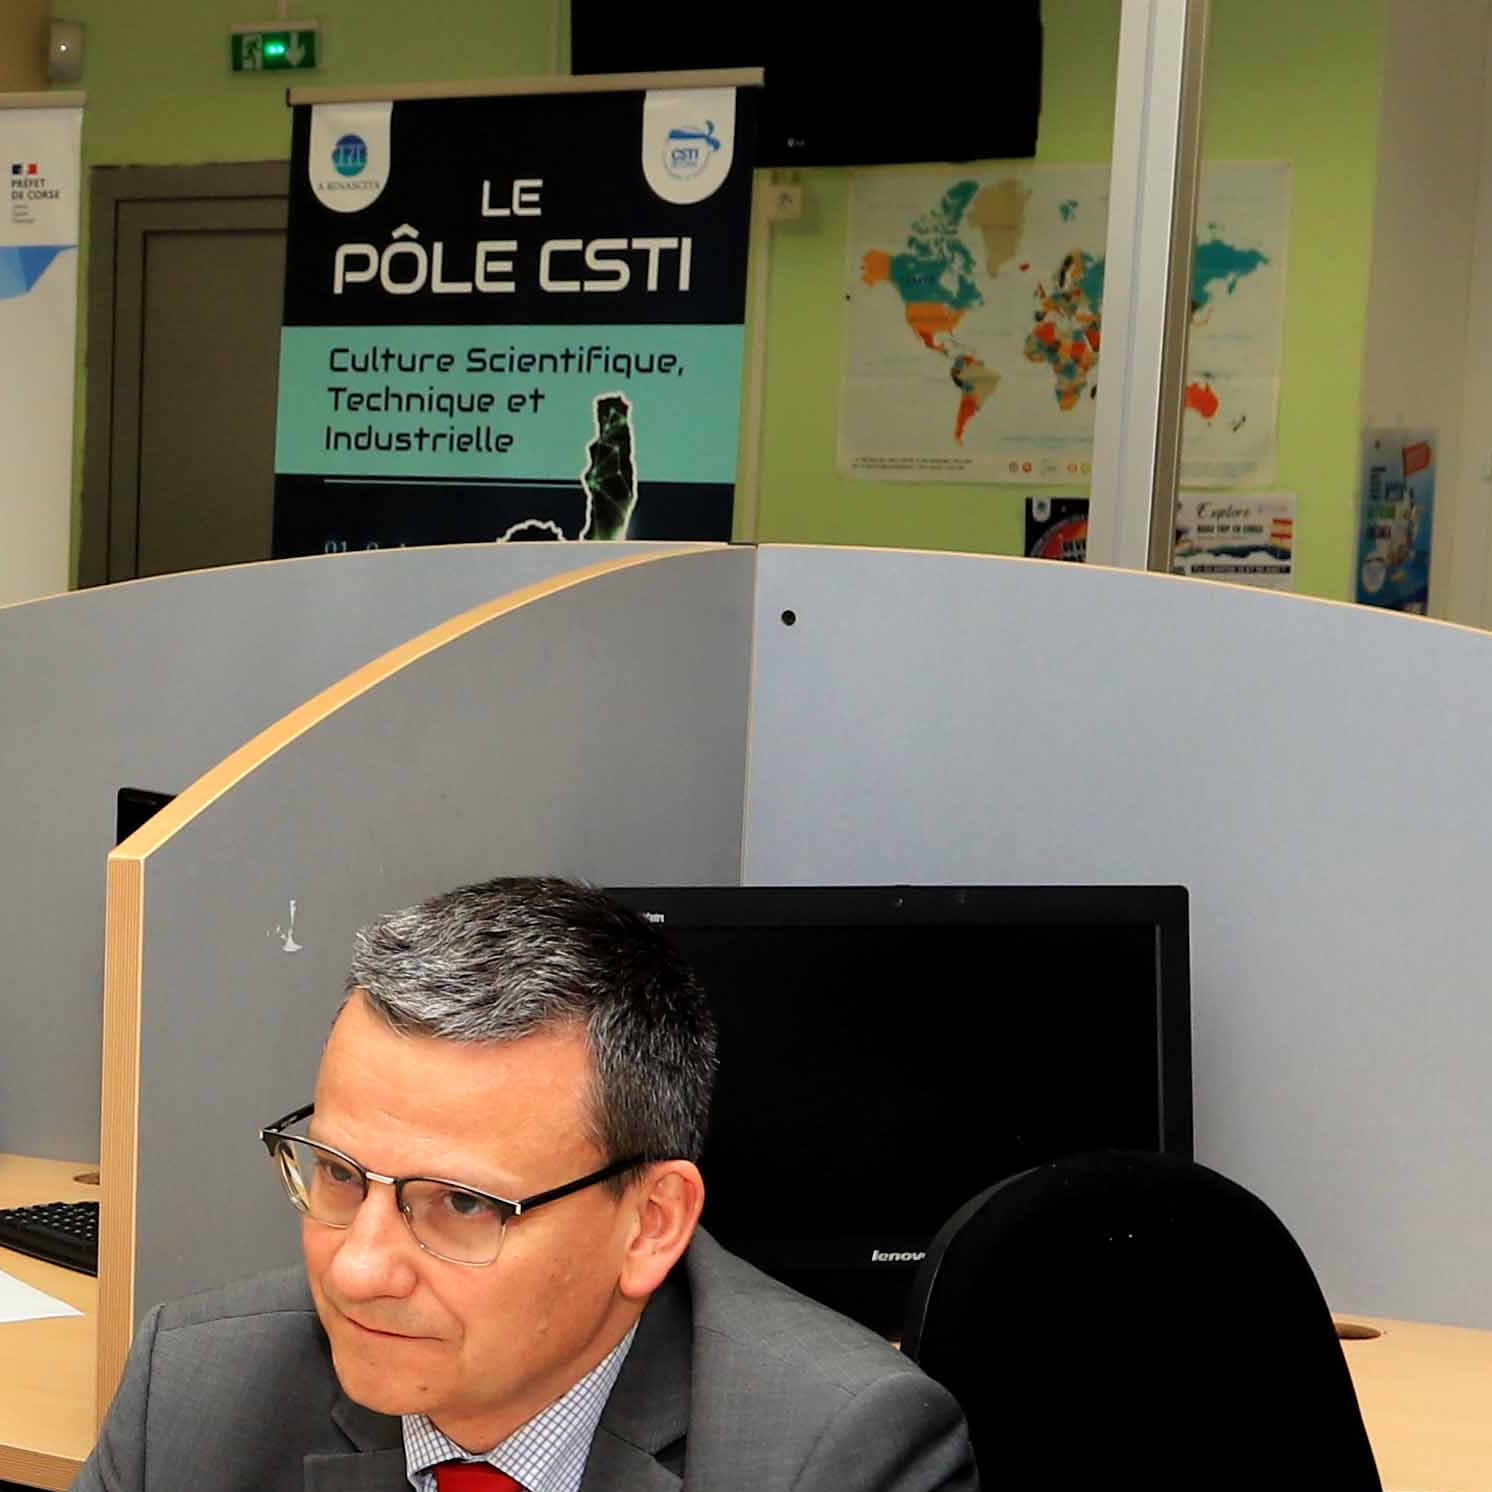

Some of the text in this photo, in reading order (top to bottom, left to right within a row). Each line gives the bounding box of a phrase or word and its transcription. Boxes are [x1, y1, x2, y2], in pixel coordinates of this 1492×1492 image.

[481, 179, 543, 217] LE
[333, 223, 692, 295] PÔLE CSTI
[329, 347, 685, 380] Culture Scientifique,
[327, 386, 545, 418] Technique et
[324, 424, 514, 453] Industrielle
